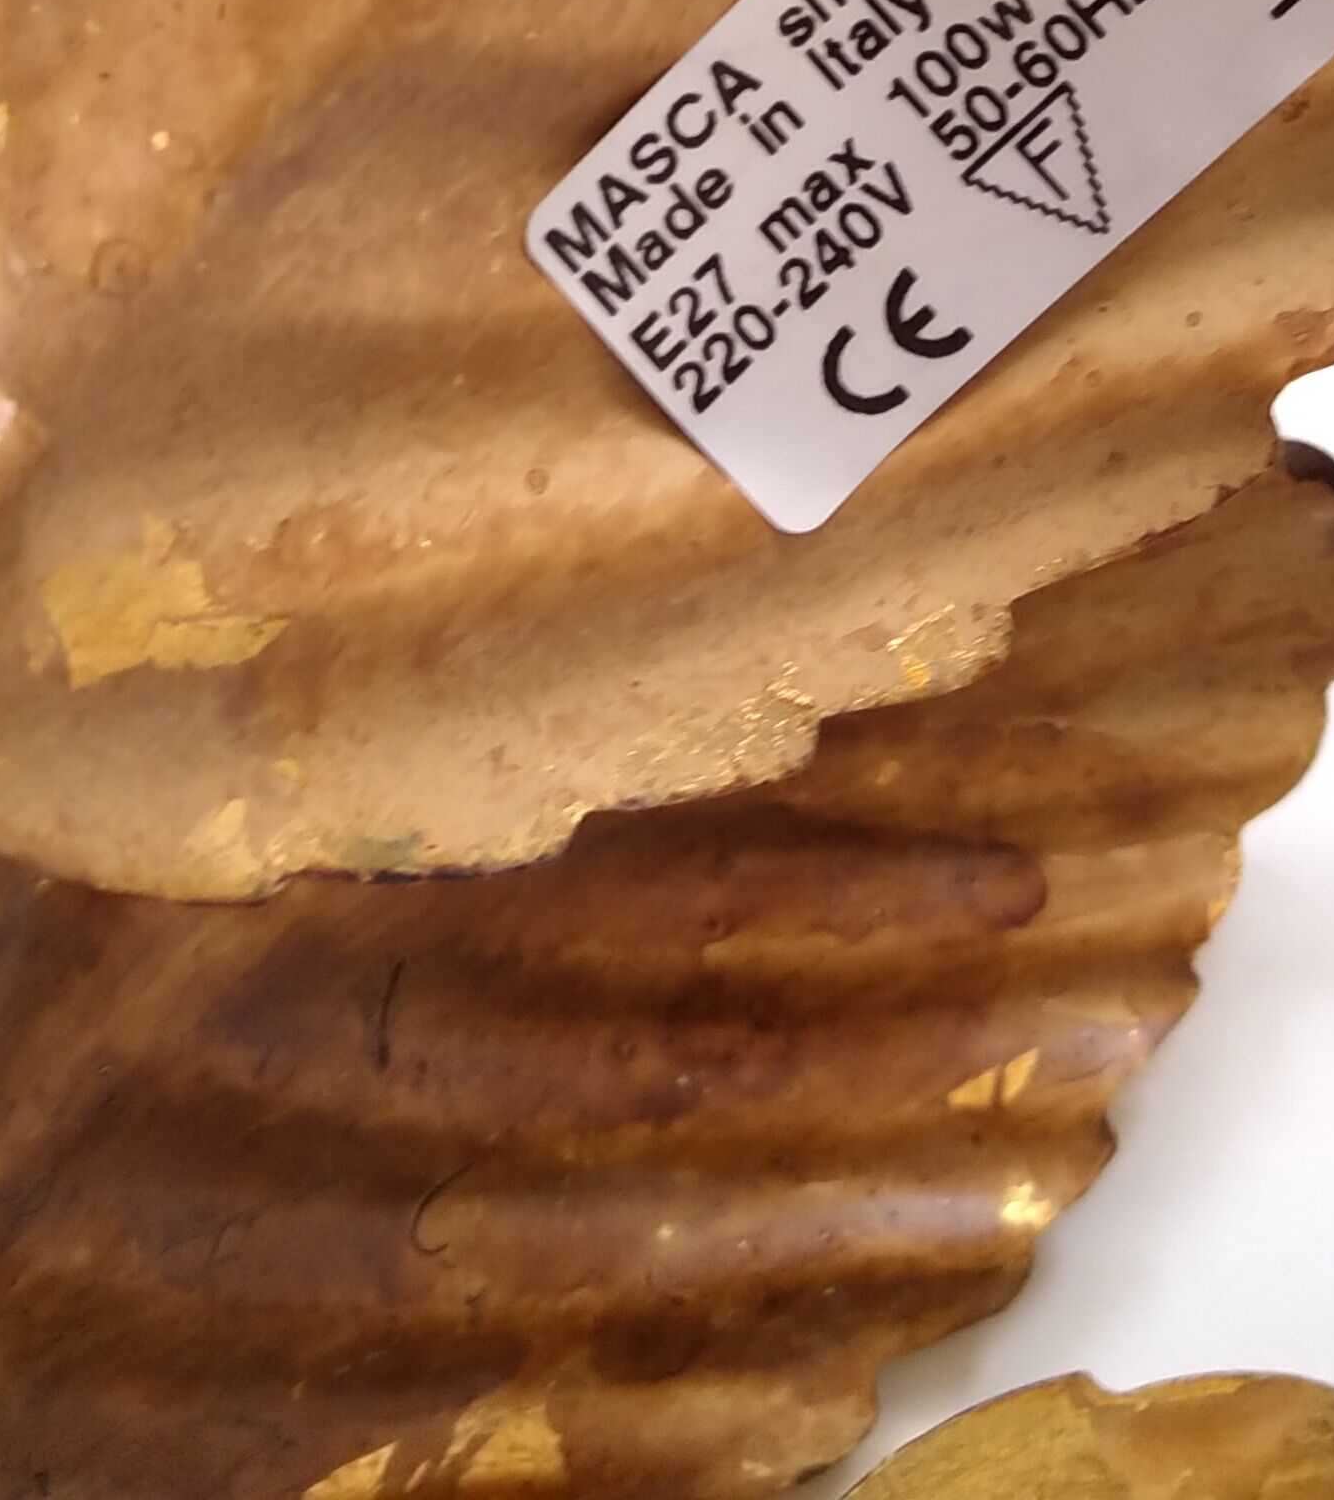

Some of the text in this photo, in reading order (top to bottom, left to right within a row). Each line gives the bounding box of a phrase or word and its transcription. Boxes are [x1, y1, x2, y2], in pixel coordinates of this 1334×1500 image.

[544, 60, 764, 275] MASCA
[579, 166, 736, 317] Made
[737, 99, 807, 158] in
[629, 251, 737, 372] E27
[756, 136, 878, 256] max
[672, 160, 915, 416] 220-240V
[818, 265, 976, 417] CE
